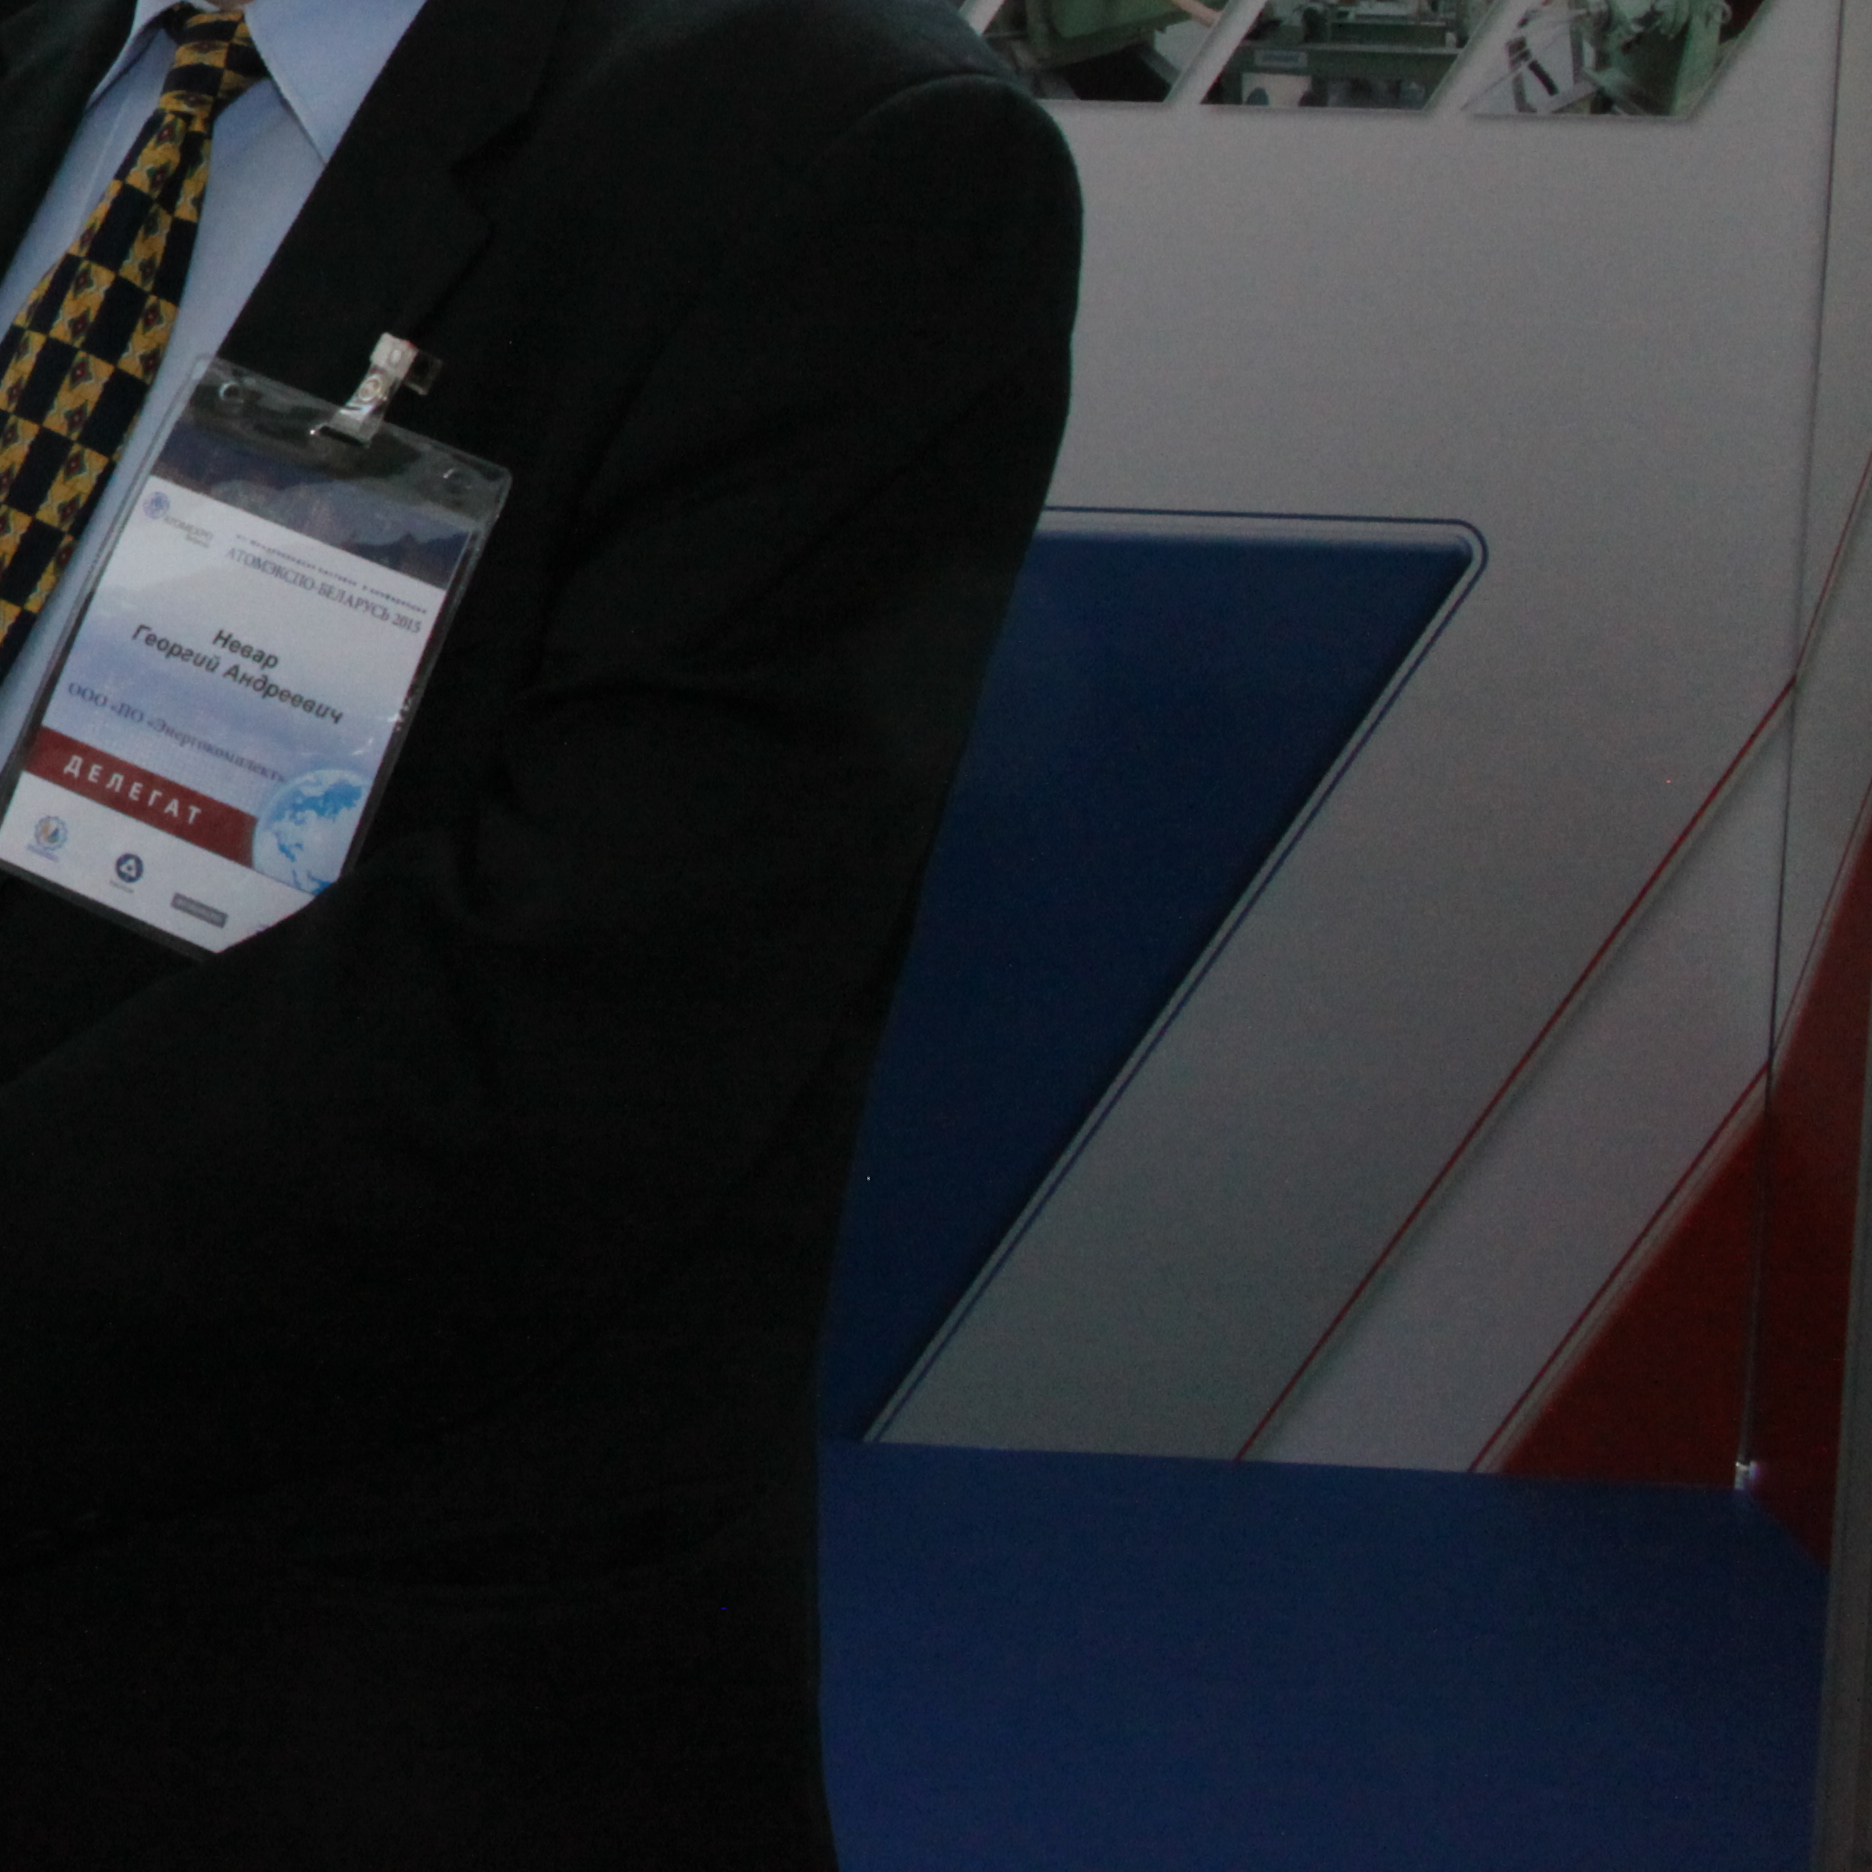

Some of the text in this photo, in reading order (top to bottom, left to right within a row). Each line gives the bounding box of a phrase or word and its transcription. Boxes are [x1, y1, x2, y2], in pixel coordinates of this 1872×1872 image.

[131, 624, 344, 725] Георгий Андреевич
[213, 629, 280, 669] Невар
[67, 682, 109, 707] ООО
[63, 755, 202, 825] ДЕЛЕГАТ
